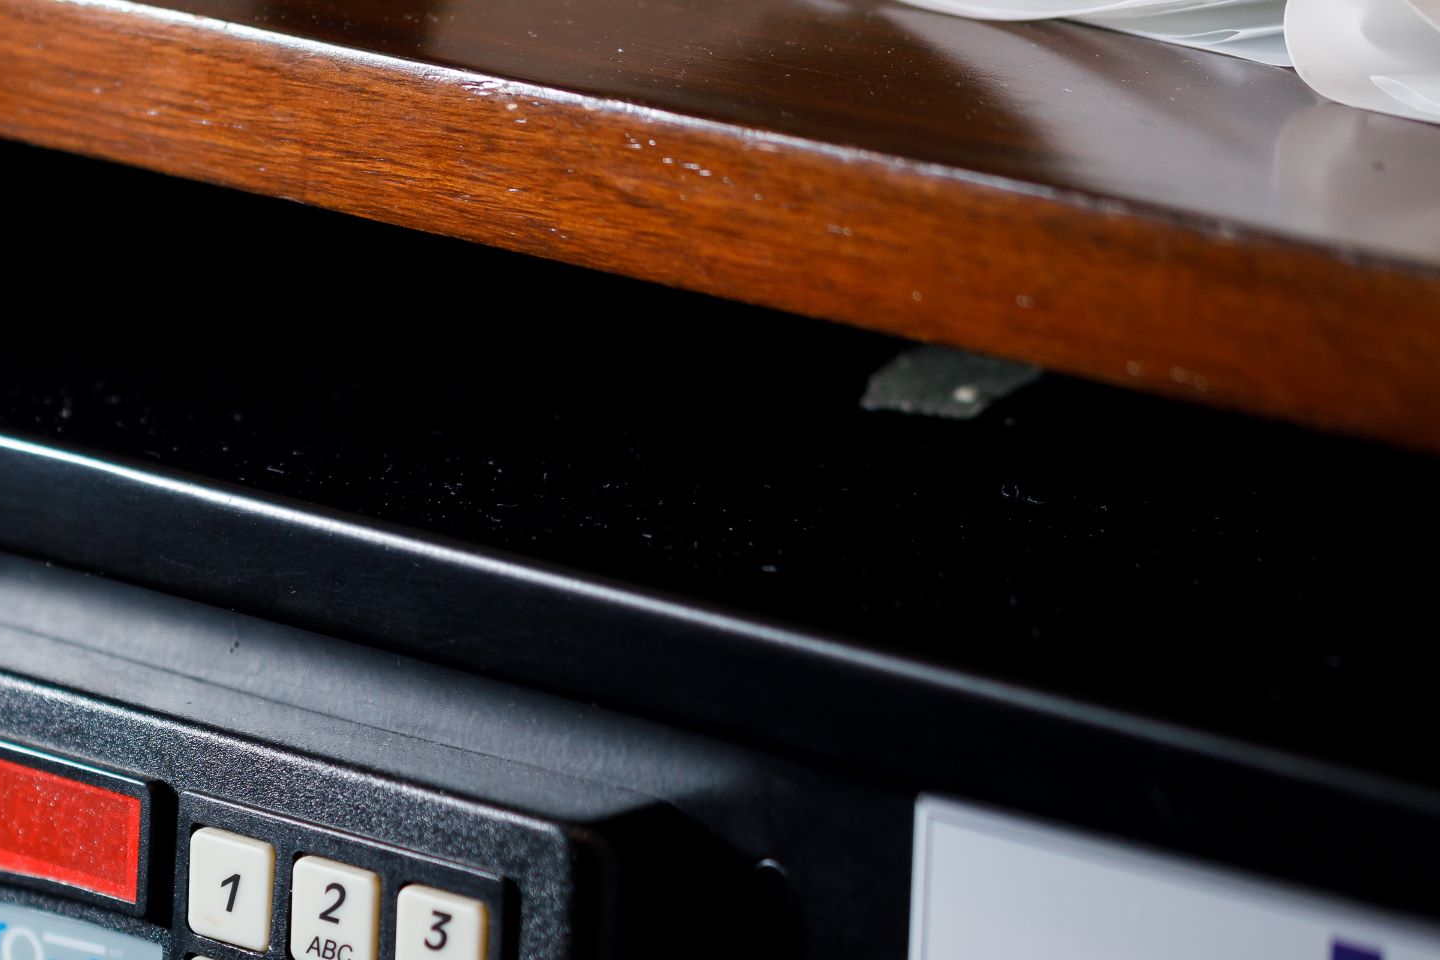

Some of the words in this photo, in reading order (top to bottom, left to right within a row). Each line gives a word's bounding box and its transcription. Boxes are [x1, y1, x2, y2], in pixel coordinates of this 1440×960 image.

[220, 873, 241, 912] 1
[319, 882, 347, 924] 2
[424, 910, 452, 951] 3
